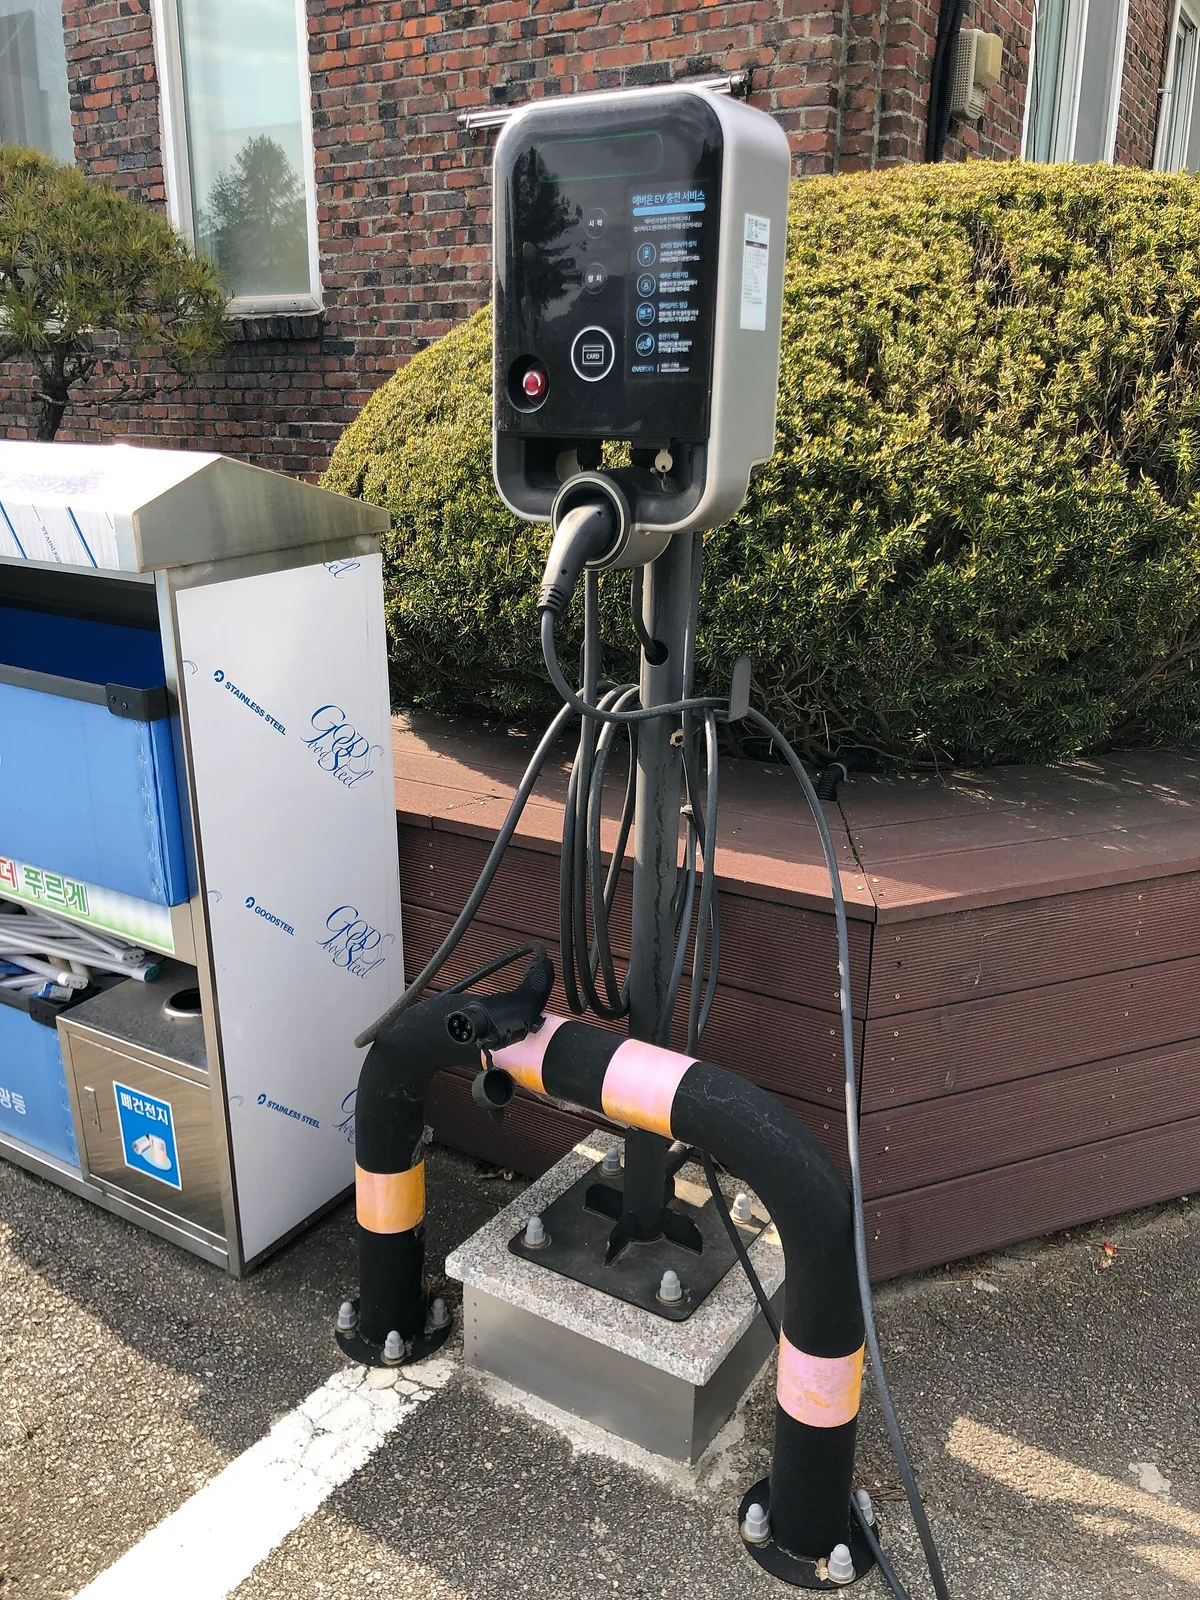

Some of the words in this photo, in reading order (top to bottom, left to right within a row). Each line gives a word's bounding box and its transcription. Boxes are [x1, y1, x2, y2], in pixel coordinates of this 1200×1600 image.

[654, 193, 665, 204] EV
[666, 191, 681, 204] 충전
[682, 190, 706, 202] 서비스
[631, 364, 654, 373] everon
[225, 681, 265, 717] STAINLESS
[264, 713, 286, 736] STEEL
[23, 866, 88, 915] 푸르게
[254, 906, 295, 936] GOODSTEEL
[120, 1092, 169, 1126] 폐건전지
[267, 1101, 301, 1120] STAINLESS
[301, 1115, 320, 1129] STEEL
